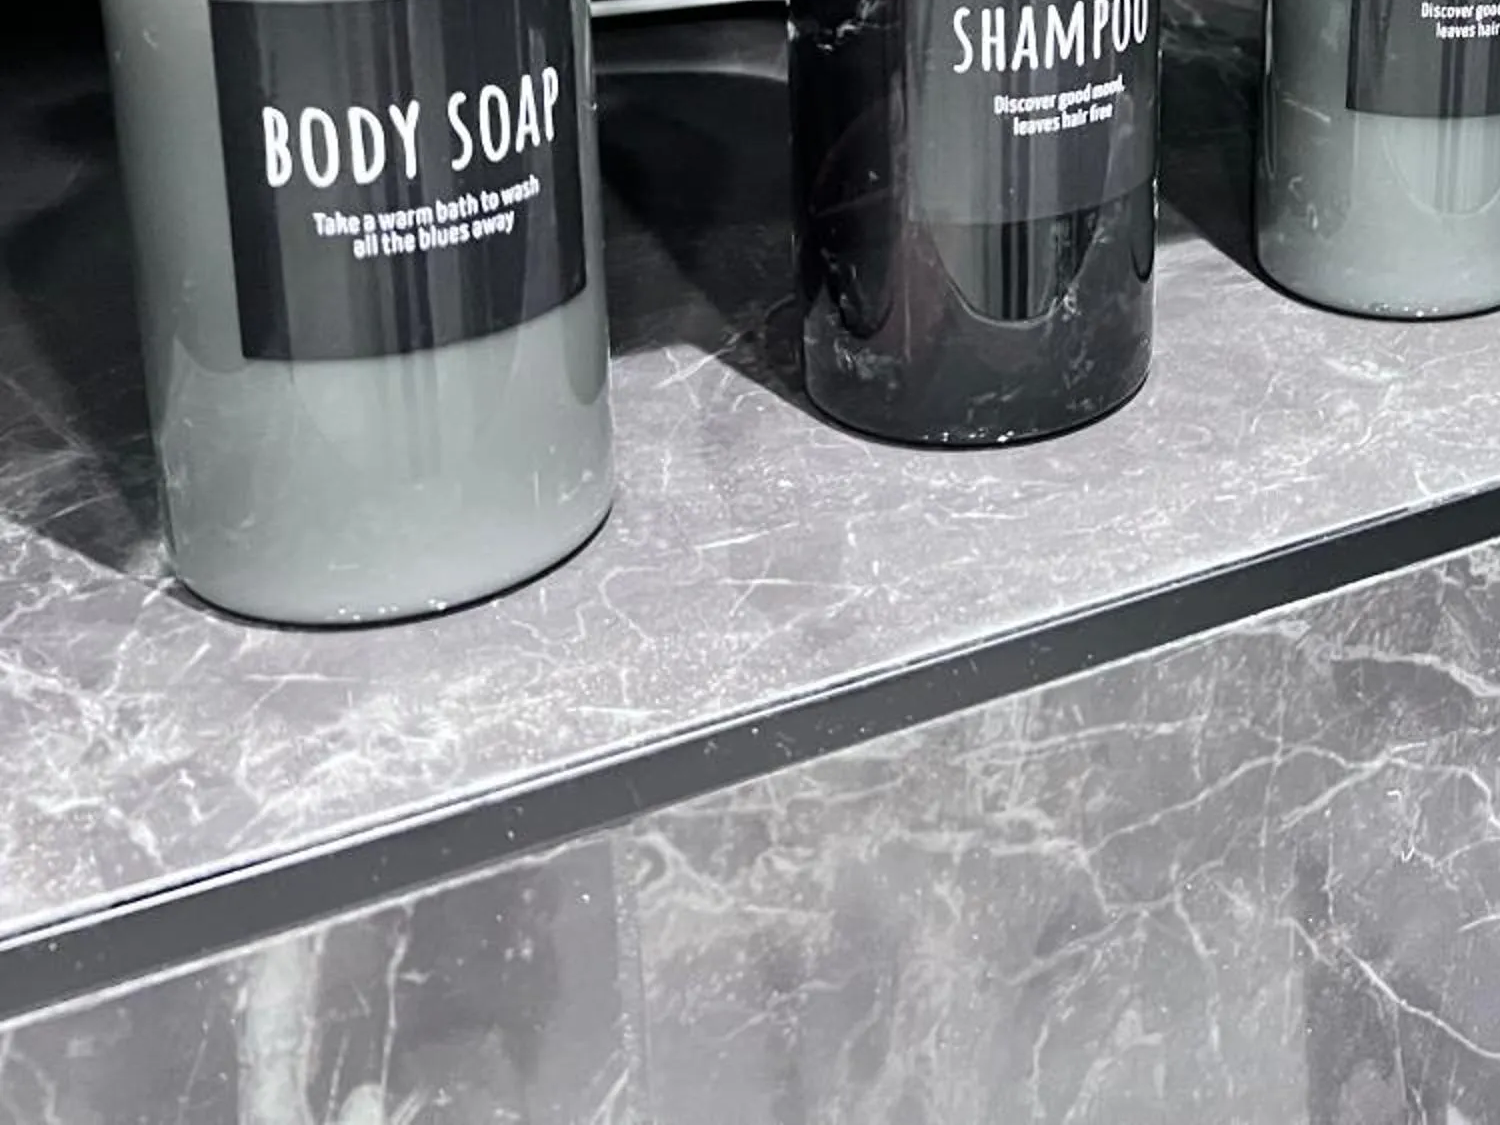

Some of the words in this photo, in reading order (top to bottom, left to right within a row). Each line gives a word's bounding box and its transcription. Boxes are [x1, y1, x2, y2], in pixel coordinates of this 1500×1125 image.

[1421, 1, 1474, 18] Discover
[1435, 23, 1476, 39] leaves
[1477, 22, 1500, 38] hair
[993, 94, 1057, 115] Discover
[1058, 83, 1091, 111] good
[262, 99, 420, 189] BODY
[447, 66, 560, 172] SOAP
[1013, 116, 1061, 137] leaves
[1061, 109, 1089, 129] hair
[1089, 103, 1113, 122] free
[312, 212, 361, 236] Take
[363, 214, 375, 232] a
[376, 207, 433, 232] warm
[435, 194, 479, 224] bath
[480, 192, 500, 213] to
[501, 174, 541, 207] wash
[353, 232, 379, 259] all
[381, 230, 417, 255] the
[418, 220, 470, 252] blues
[472, 208, 516, 240] away
